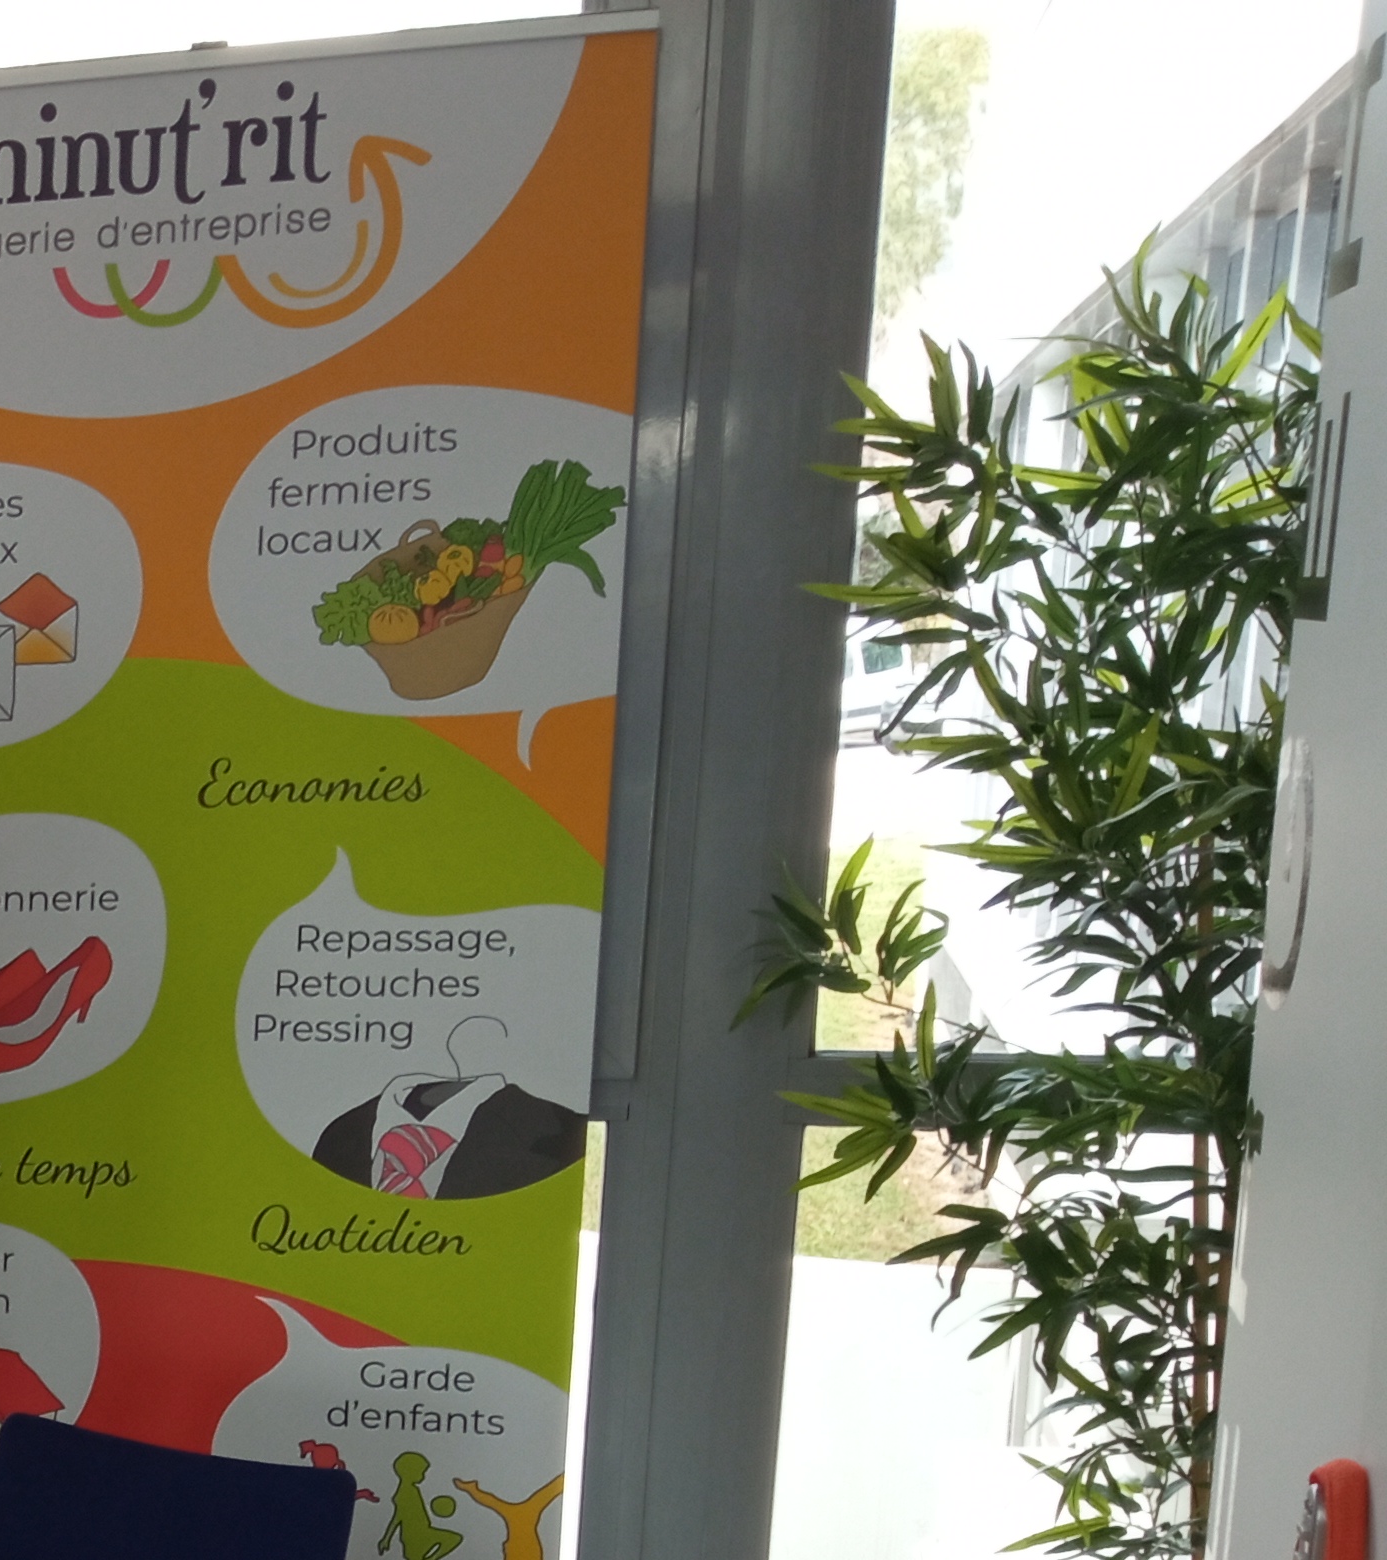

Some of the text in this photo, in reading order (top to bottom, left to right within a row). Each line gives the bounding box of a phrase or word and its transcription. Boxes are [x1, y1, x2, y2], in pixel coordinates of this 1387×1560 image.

[97, 204, 333, 253] d'entreprise
[292, 421, 459, 460] Produits
[267, 472, 432, 510] fermiers
[256, 525, 384, 557] locaux
[197, 757, 431, 810] Economies
[295, 922, 517, 960] Repassage,
[274, 967, 481, 1000] Retouches
[252, 1013, 415, 1050] Pressing
[15, 1148, 138, 1200] temps
[250, 1203, 474, 1259] Quotidien
[358, 1359, 476, 1394] Garde
[325, 1399, 506, 1438] d'enfants
